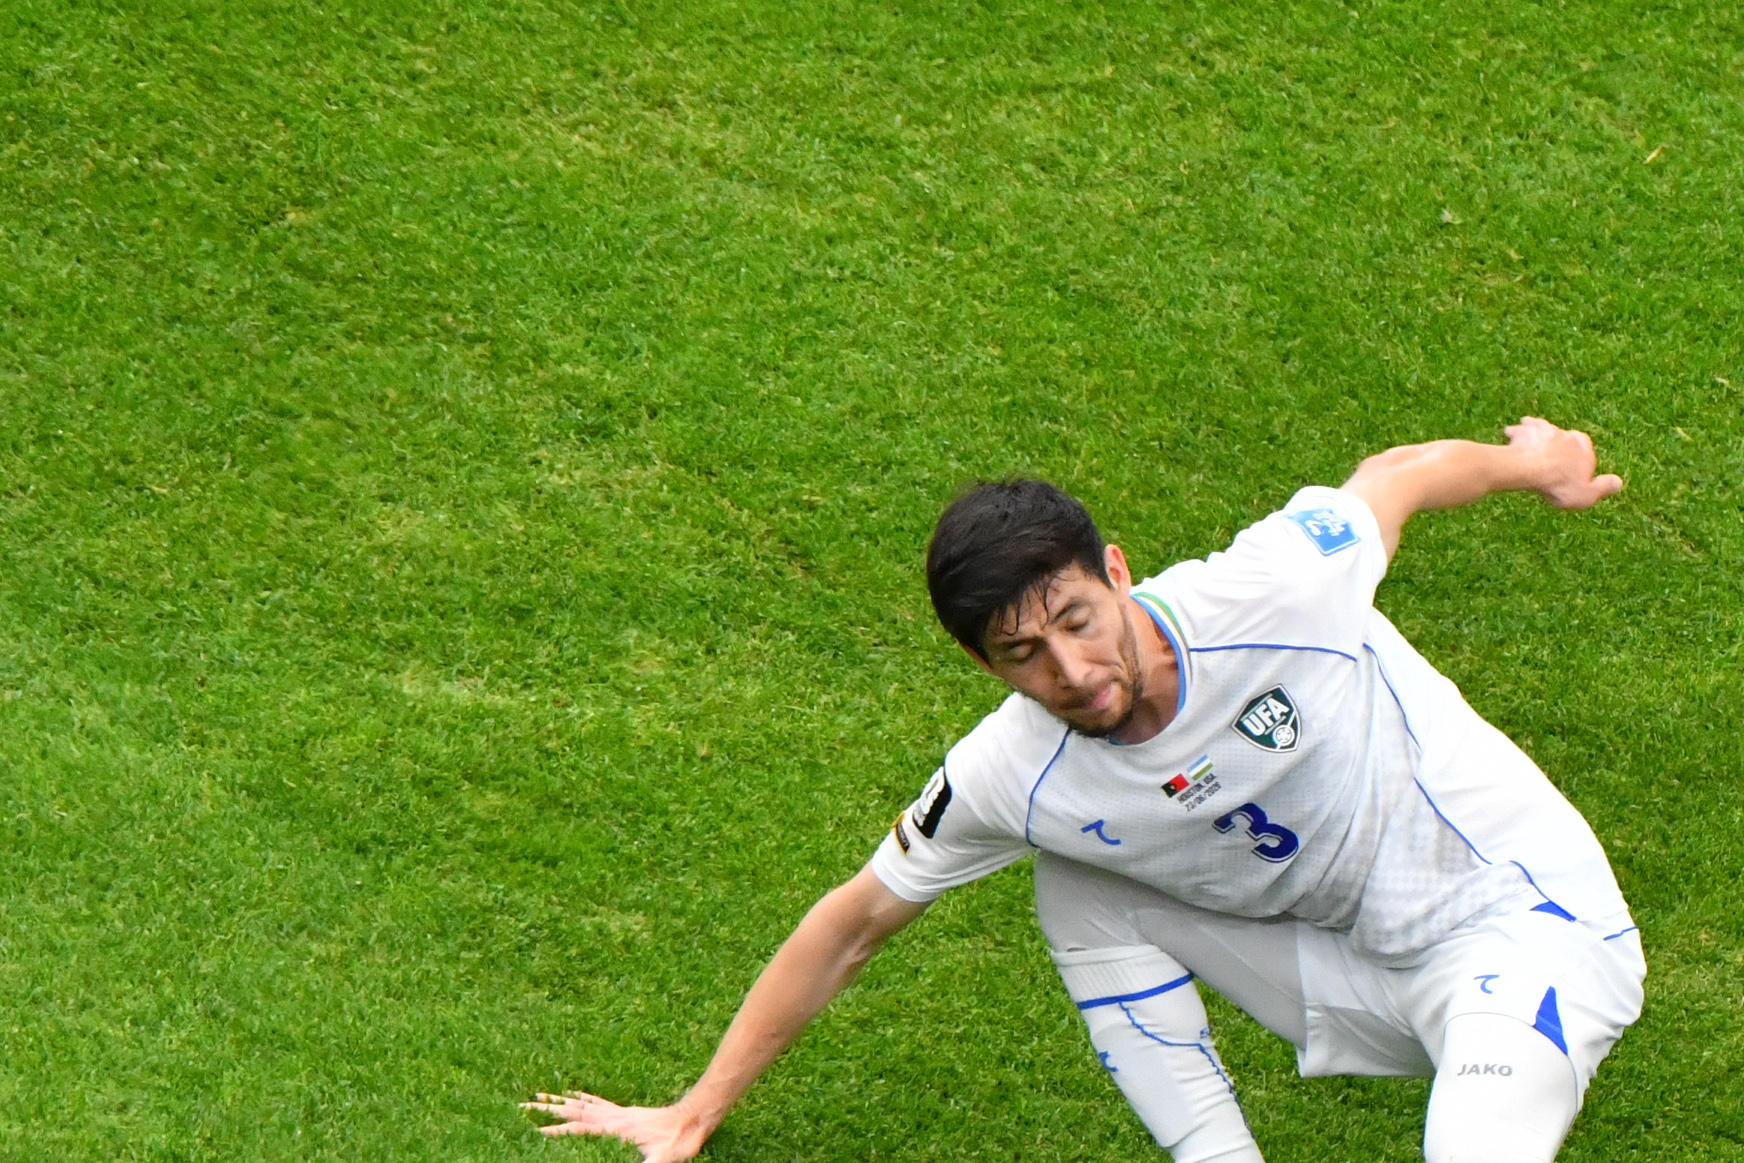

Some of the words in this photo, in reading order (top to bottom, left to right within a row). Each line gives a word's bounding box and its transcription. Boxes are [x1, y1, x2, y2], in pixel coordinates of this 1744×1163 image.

[1242, 697, 1290, 736] UFA
[1211, 802, 1299, 863] 3
[1456, 1063, 1513, 1077] JAKO
